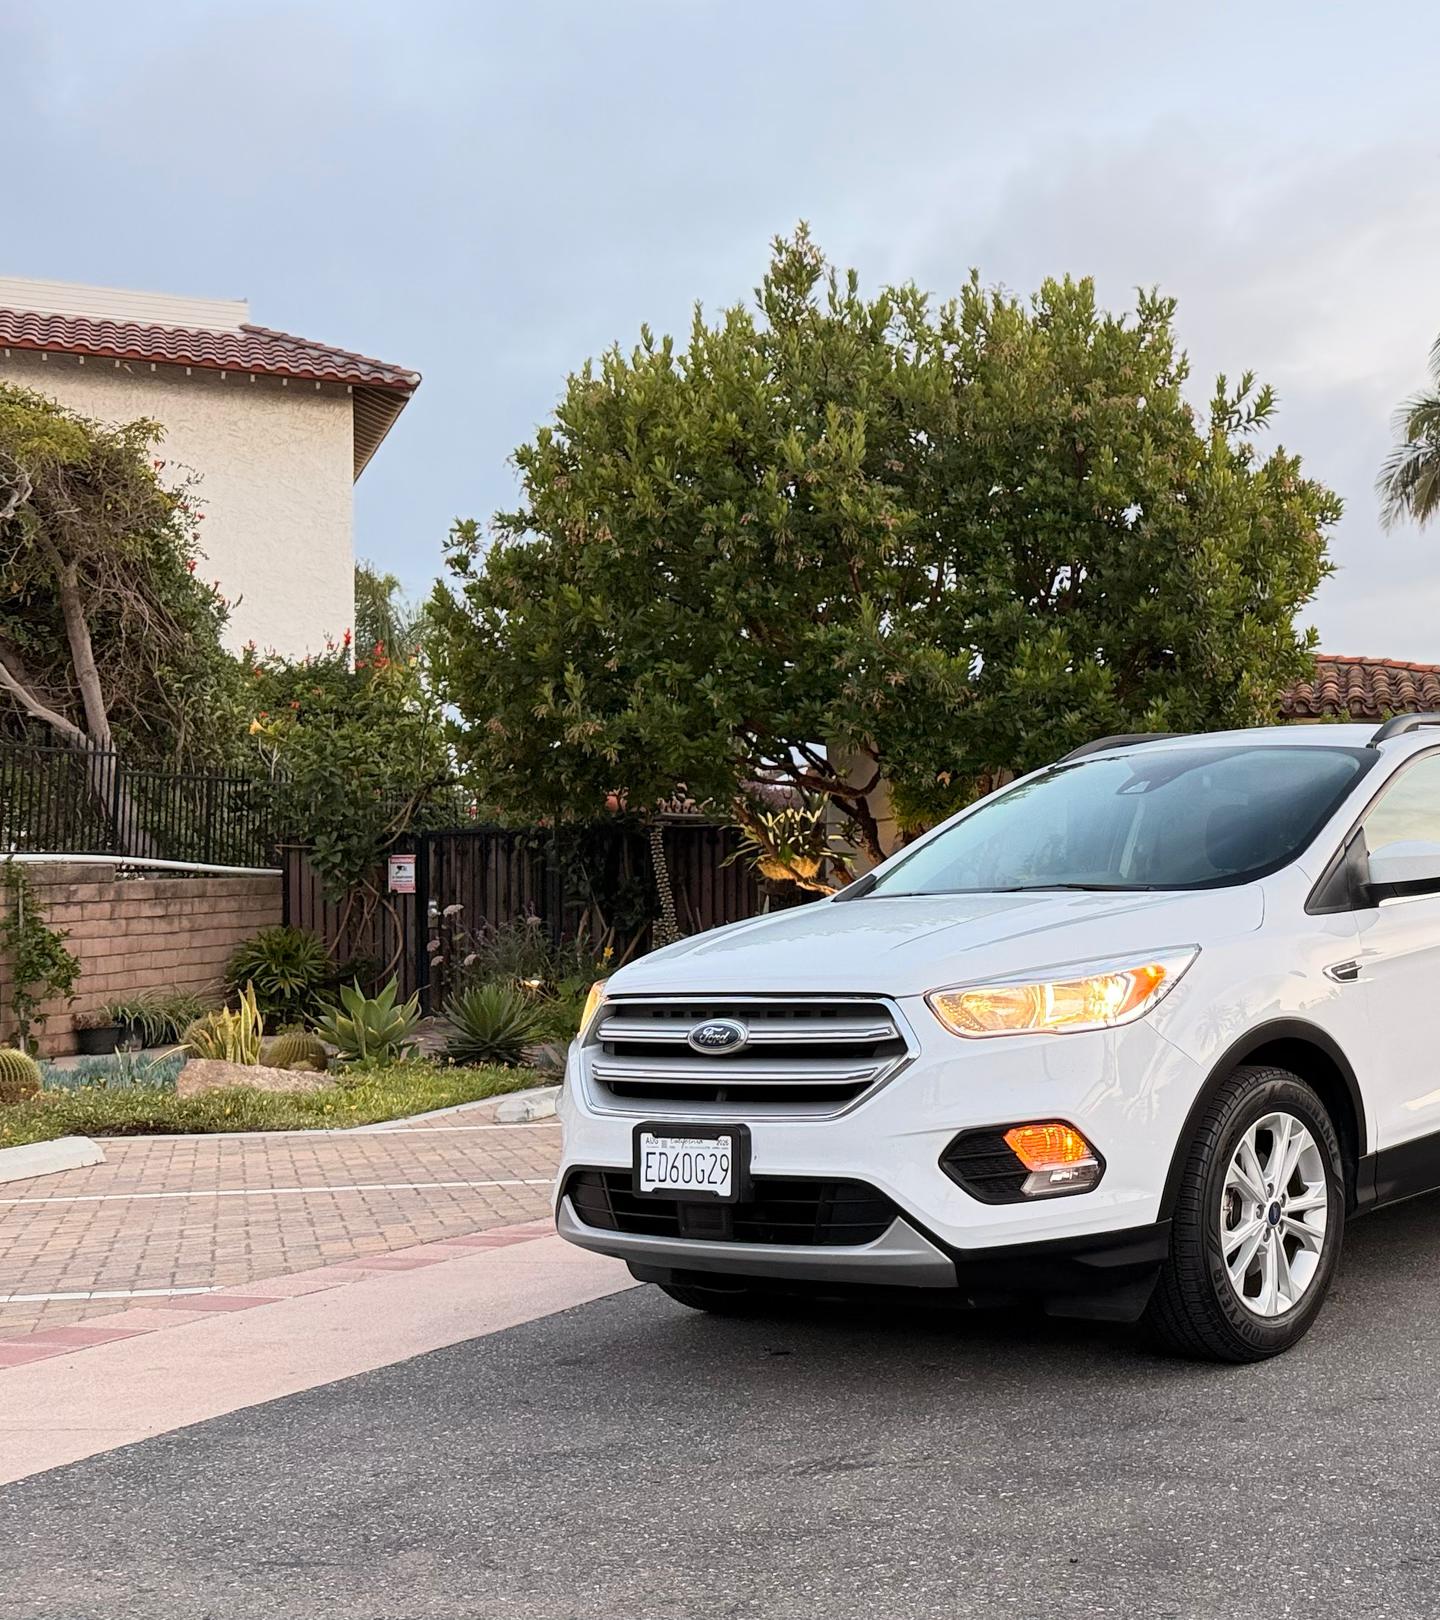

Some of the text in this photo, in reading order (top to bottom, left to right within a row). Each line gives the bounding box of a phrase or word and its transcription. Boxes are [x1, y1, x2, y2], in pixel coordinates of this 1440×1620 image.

[699, 1026, 731, 1045] Ford
[645, 1136, 659, 1145] AUG
[645, 1152, 730, 1185] ED60G29
